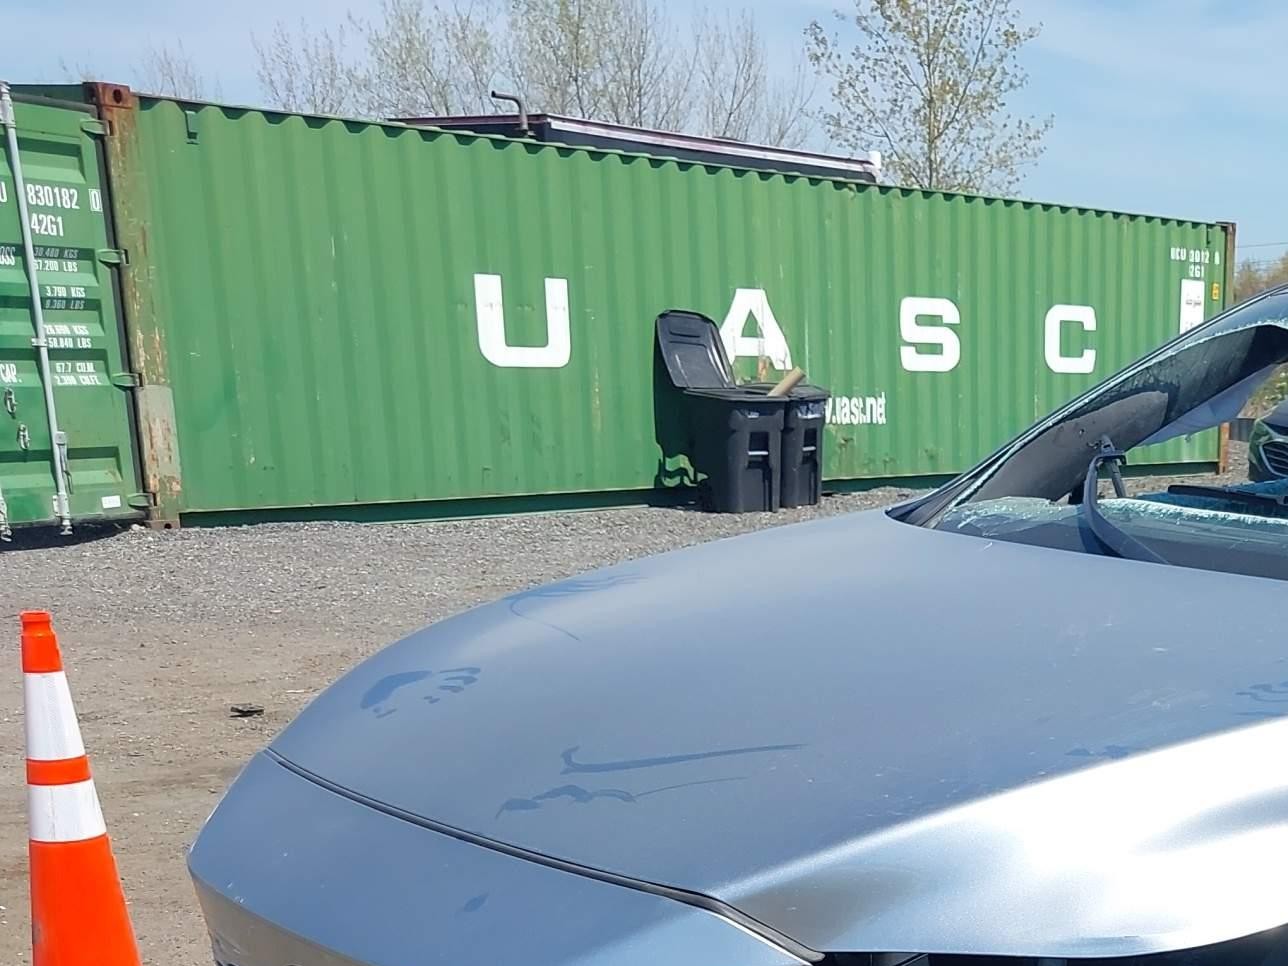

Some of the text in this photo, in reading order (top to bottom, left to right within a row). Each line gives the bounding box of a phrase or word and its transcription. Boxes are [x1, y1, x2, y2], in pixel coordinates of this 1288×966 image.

[27, 184, 80, 209] 830182
[31, 213, 64, 236] 42G1
[63, 261, 78, 272] LBS
[70, 287, 85, 297] KGS
[77, 337, 91, 348] LBS
